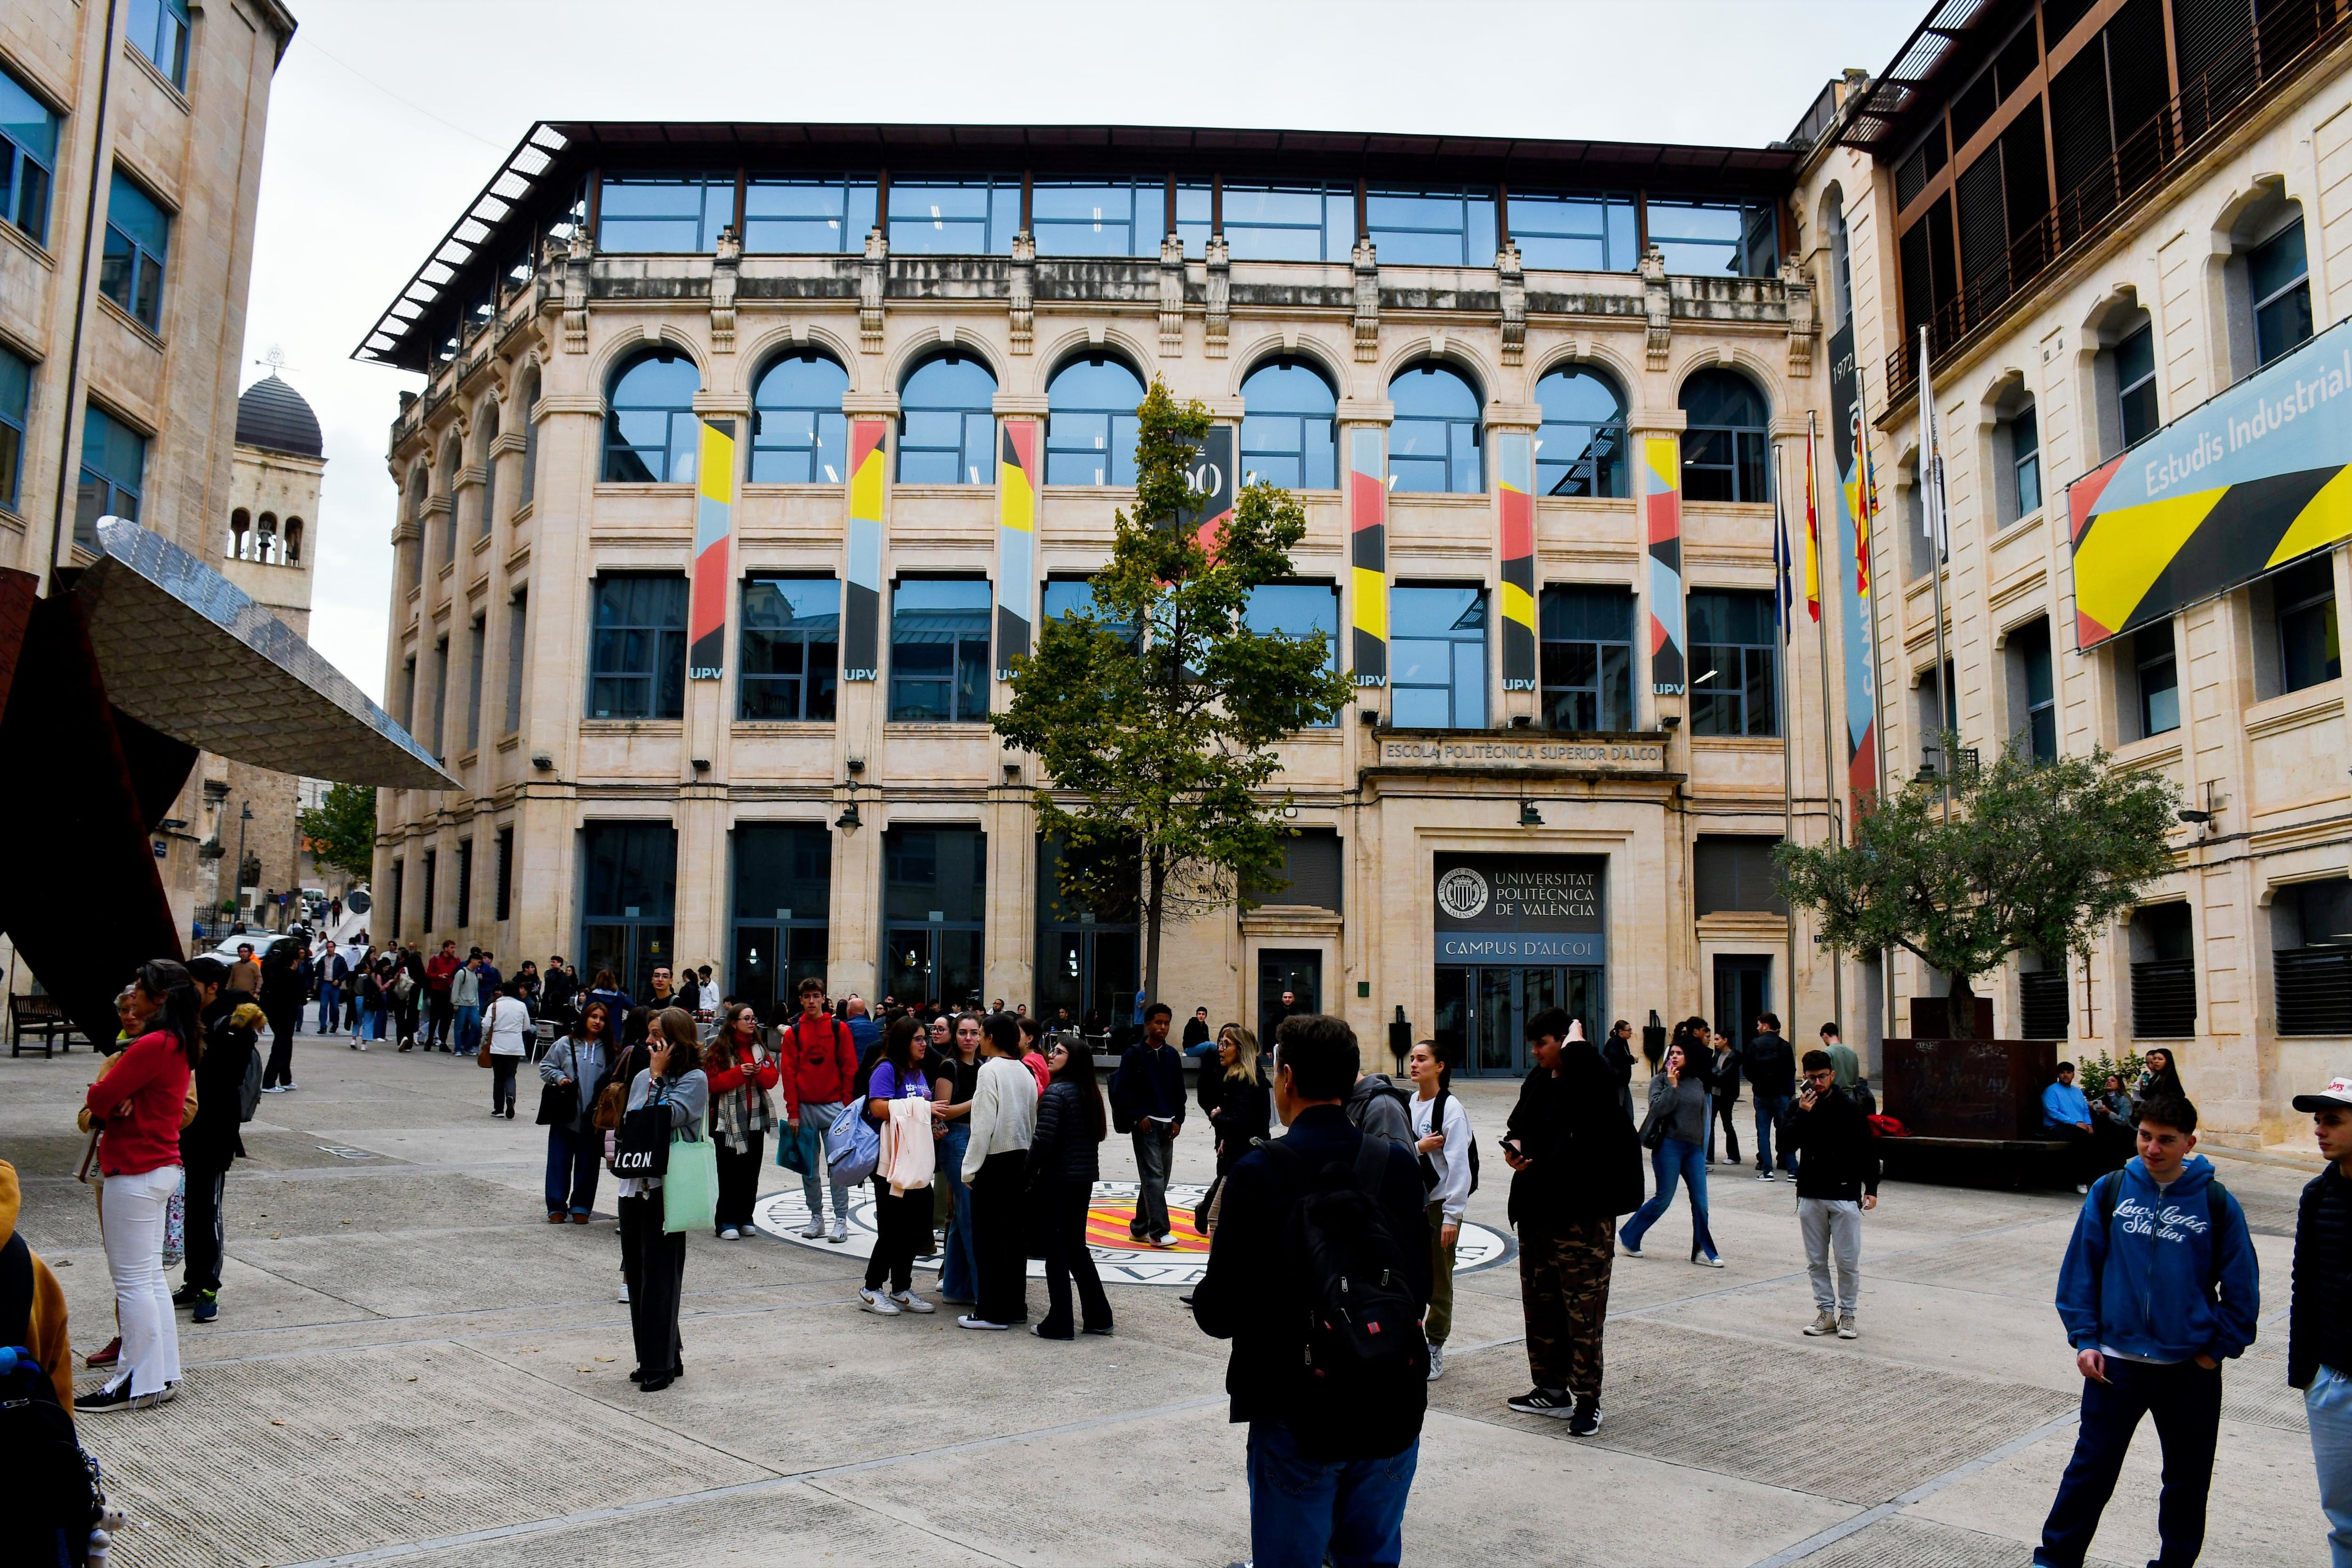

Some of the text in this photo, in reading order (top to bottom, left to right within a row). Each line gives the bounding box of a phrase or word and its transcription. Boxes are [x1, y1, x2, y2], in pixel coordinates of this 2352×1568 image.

[1833, 352, 1853, 384] 1972
[2145, 348, 2352, 497] Estudis Industrial
[689, 667, 723, 679] UPV
[843, 669, 878, 681] UPV
[1353, 675, 1386, 687] UPV
[1502, 679, 1535, 691] UPV
[1653, 684, 1685, 695] UPV
[1387, 744, 1439, 758] ESCOLA
[1445, 743, 1534, 759] POLITÈCNICA
[1540, 747, 1606, 760] SUPERIOR
[1495, 873, 1595, 885] UNIVERSITAT
[1496, 885, 1595, 901] POLITÈCNICA
[1495, 901, 1595, 916] DE VALÈNCIA
[1445, 941, 1517, 955] CAMPUS
[2113, 1198, 2209, 1234] Low Lights
[2122, 1215, 2187, 1243] Studios
